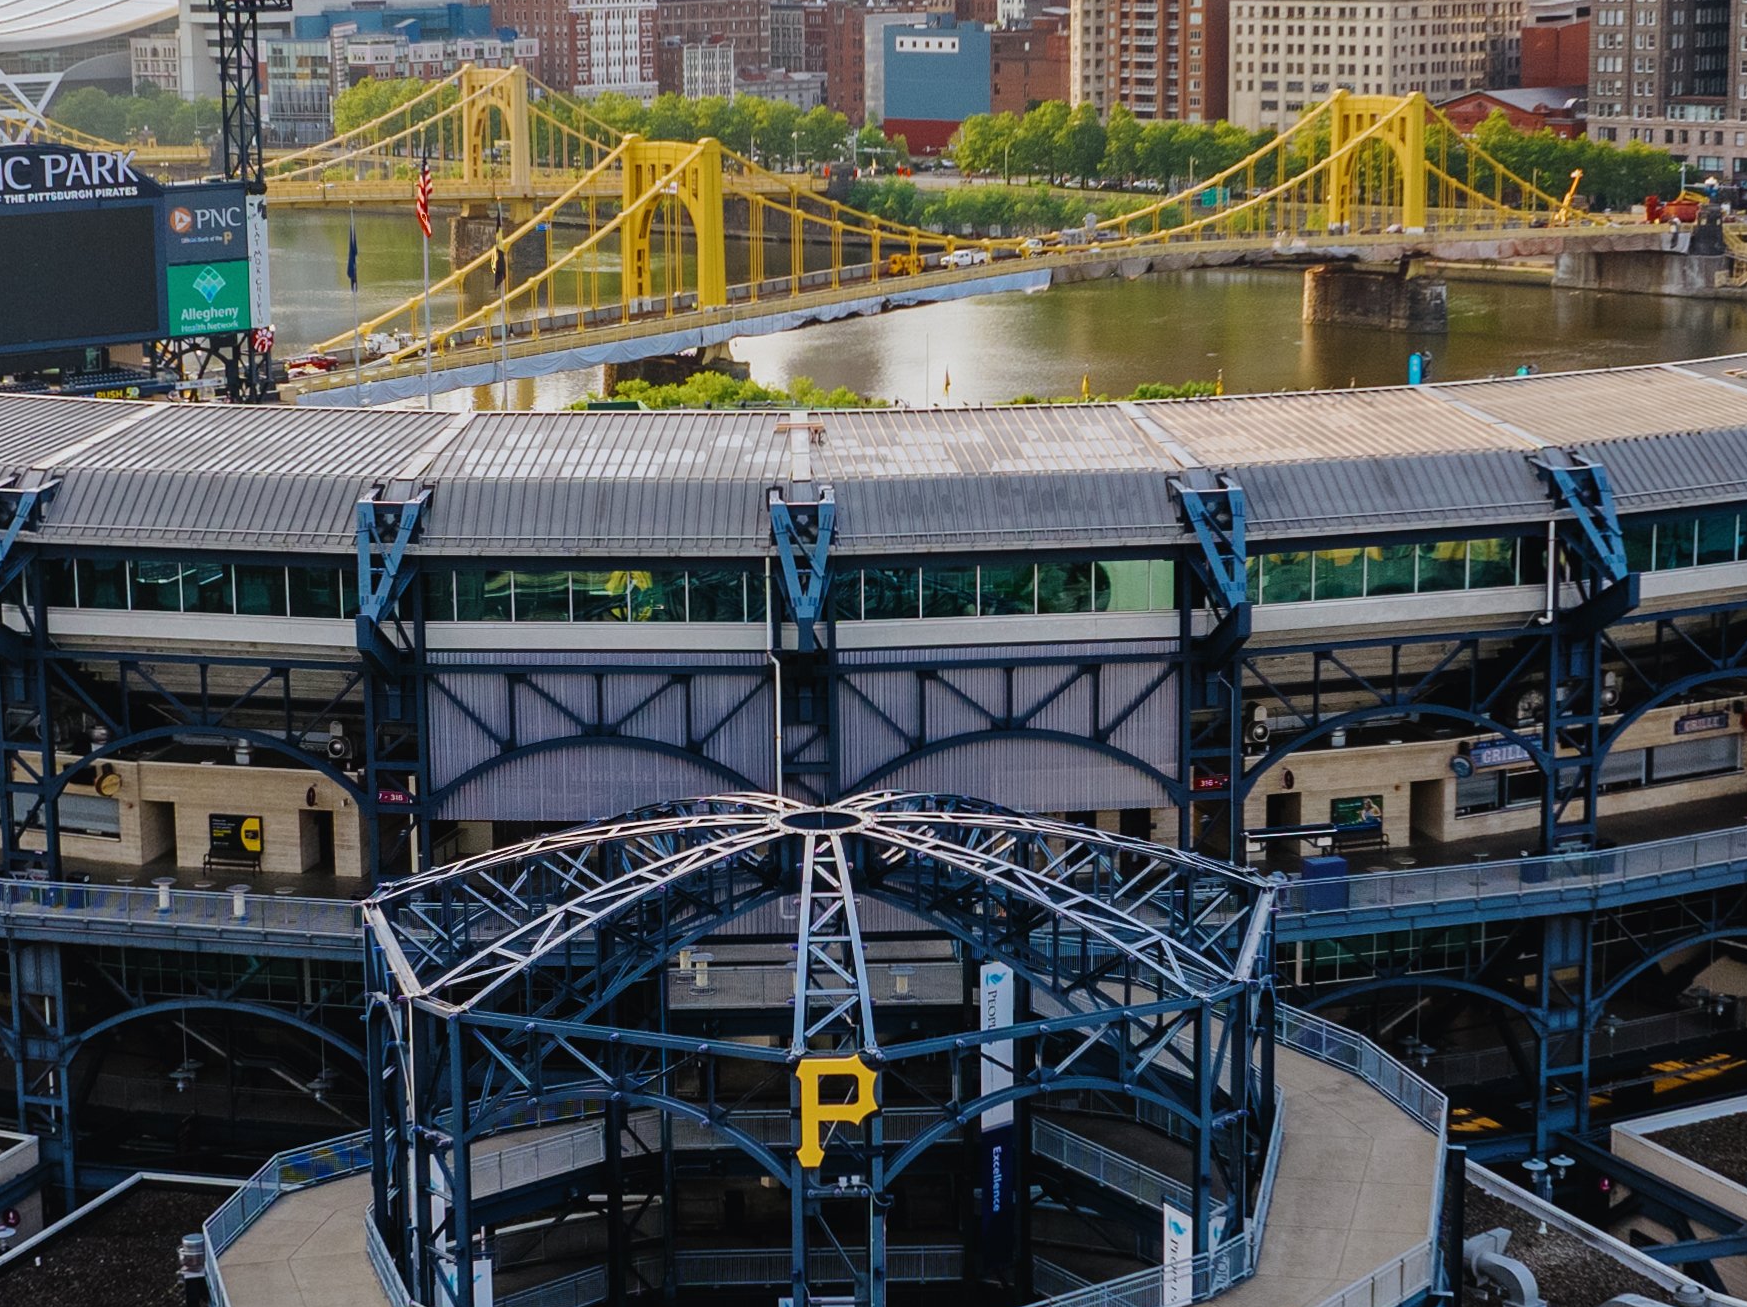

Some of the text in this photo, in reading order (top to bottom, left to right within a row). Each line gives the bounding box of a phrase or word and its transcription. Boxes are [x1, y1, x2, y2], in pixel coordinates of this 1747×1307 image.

[39, 150, 139, 189] PARK
[4, 193, 25, 204] THE
[28, 189, 93, 203] PITTSBURGH
[95, 186, 138, 198] PIRATES
[195, 206, 242, 229] PNC
[181, 305, 239, 324] Allegheny
[181, 319, 239, 333] Health Network
[795, 1056, 881, 1168] P
[992, 1146, 1002, 1213] Excellence
